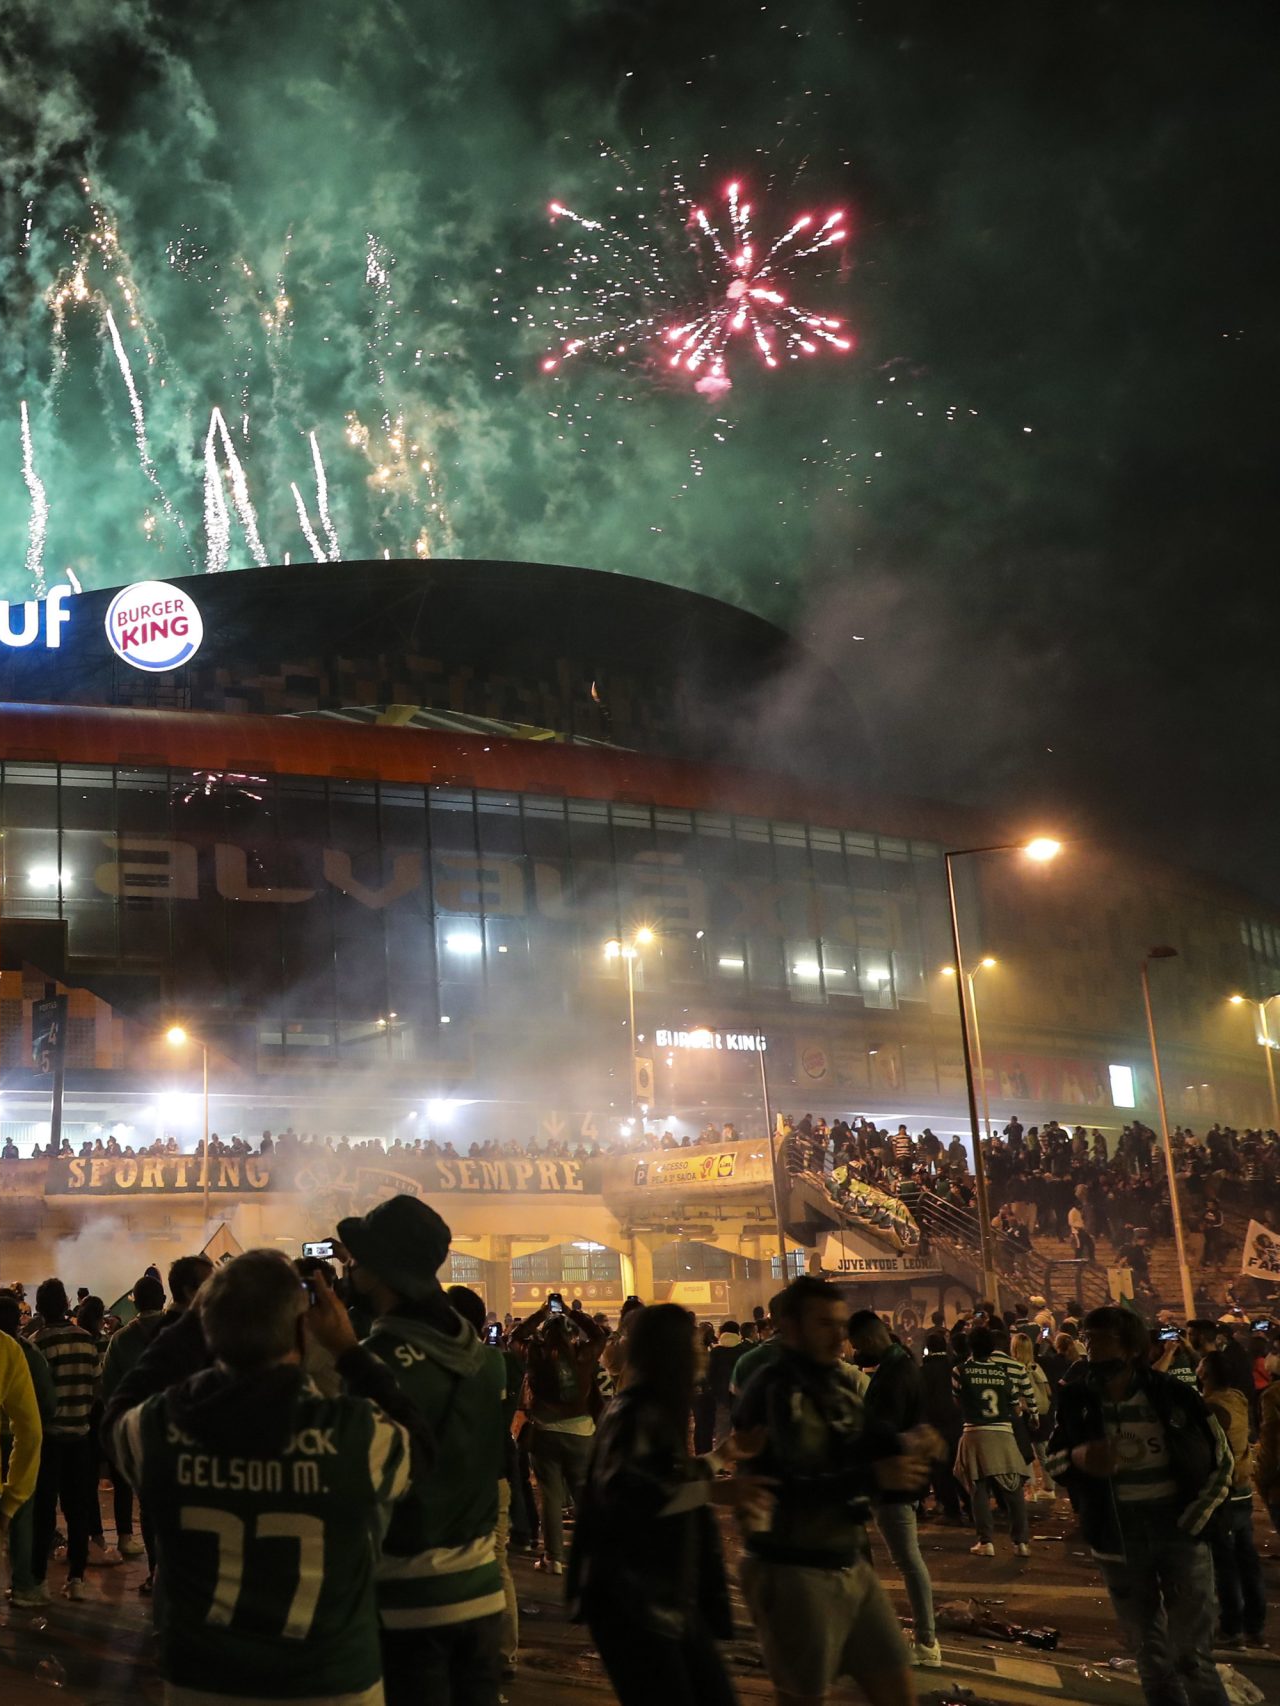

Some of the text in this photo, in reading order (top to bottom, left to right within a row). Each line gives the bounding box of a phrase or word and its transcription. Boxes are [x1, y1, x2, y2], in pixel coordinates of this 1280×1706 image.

[118, 600, 184, 627] BURGER
[122, 616, 189, 650] KING
[726, 1034, 767, 1051] KING
[41, 1050, 50, 1073] 5
[581, 1110, 599, 1140] 4
[68, 1156, 584, 1191] SPORTING SEMPRE
[838, 1258, 898, 1270] JUVENTUDE
[964, 1367, 987, 1376] SUPER
[971, 1377, 1005, 1386] BERNARDO
[982, 1388, 1000, 1418] 3
[177, 1453, 330, 1494] GELSON M.
[178, 1505, 325, 1640] 77
